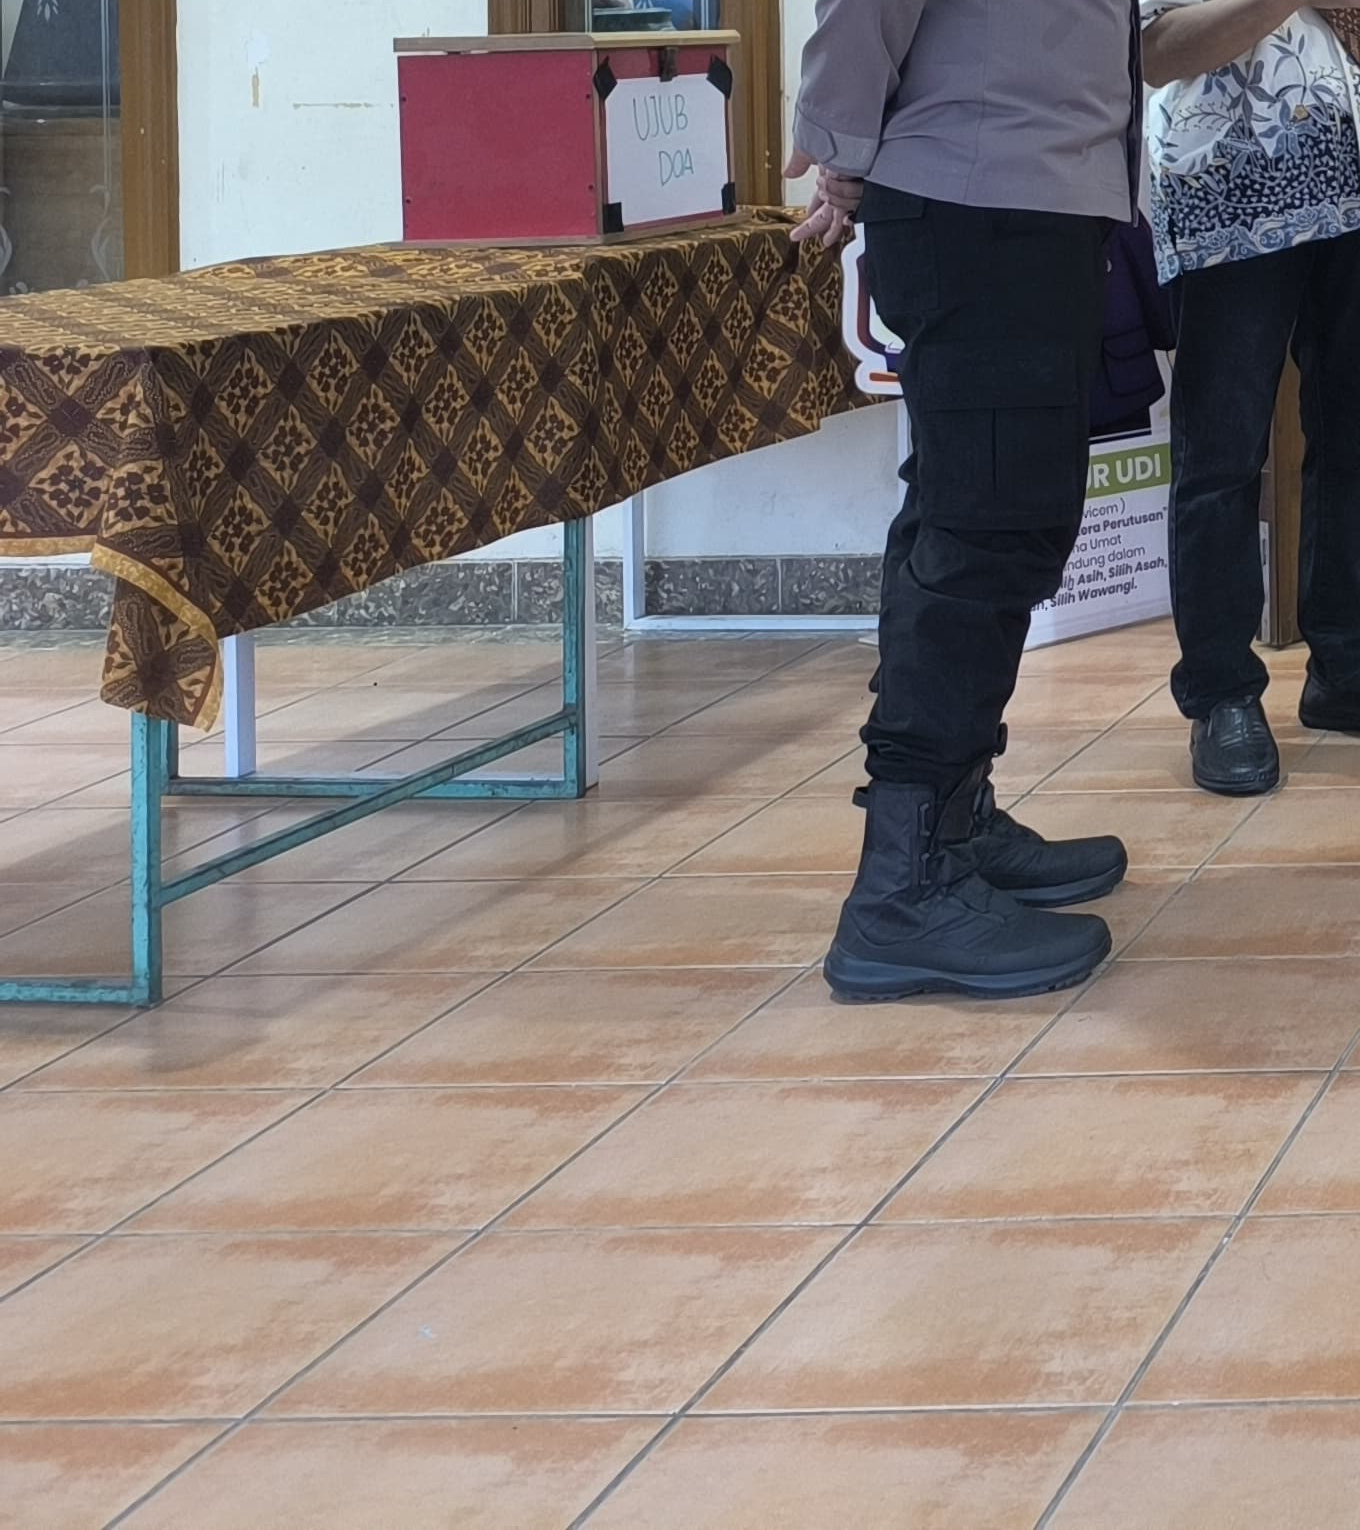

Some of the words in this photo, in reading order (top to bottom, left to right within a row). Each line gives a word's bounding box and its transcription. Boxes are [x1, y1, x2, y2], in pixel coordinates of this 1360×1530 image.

[633, 94, 688, 141] UJUB
[659, 148, 694, 186] DOA
[1116, 453, 1161, 484] UDI
[1090, 534, 1121, 551] Umat
[1108, 545, 1145, 562] dalam
[1077, 570, 1107, 586] Asih,
[1108, 562, 1133, 579] Silih
[1134, 556, 1168, 573] Asah,
